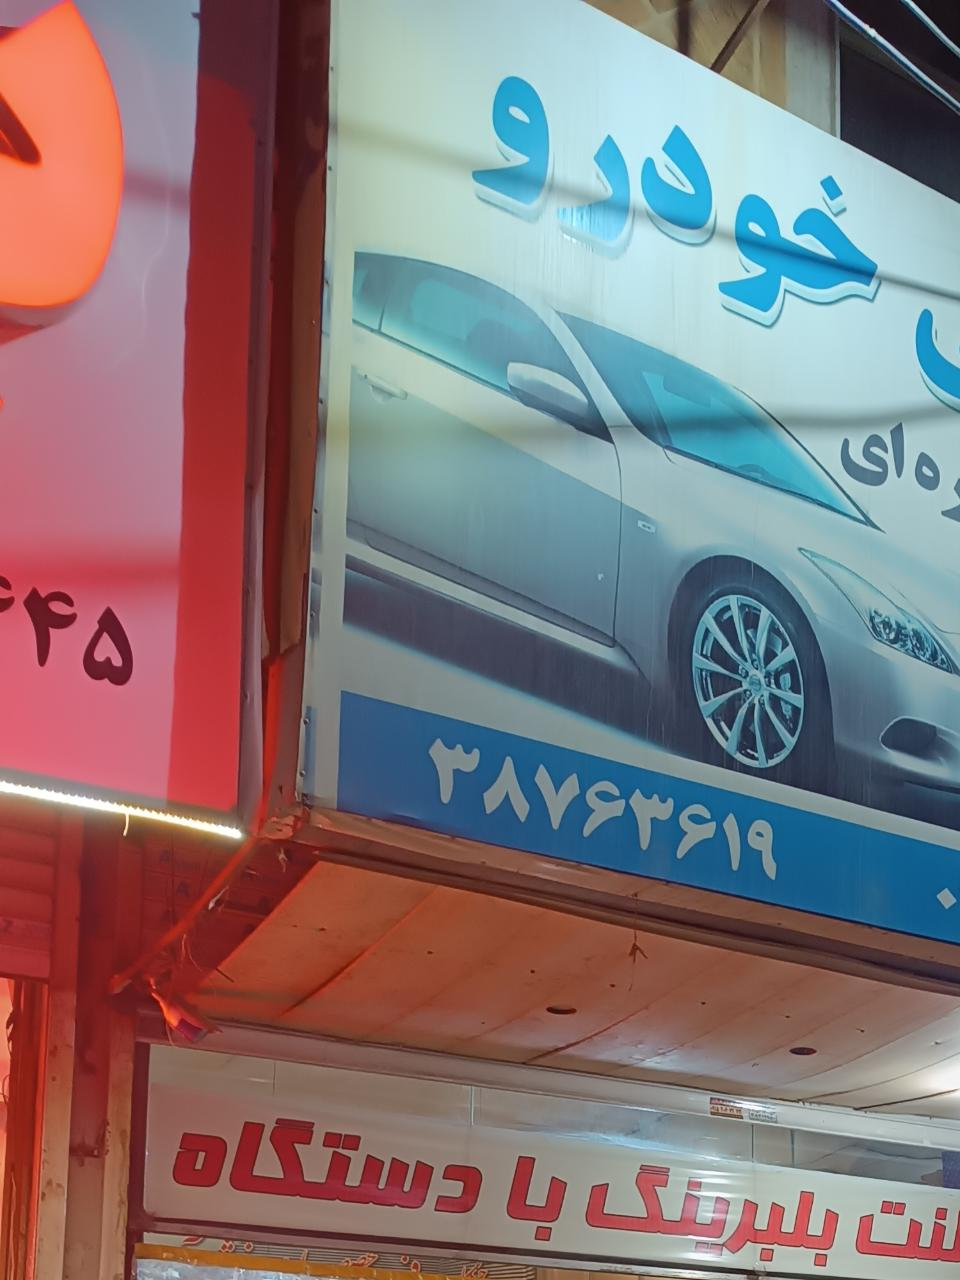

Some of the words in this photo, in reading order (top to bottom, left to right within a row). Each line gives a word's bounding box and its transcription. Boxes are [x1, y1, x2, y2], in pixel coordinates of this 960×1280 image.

[471, 75, 881, 327] خودرو
[428, 738, 777, 881] ۳۸۷۶۳۶۱۹
[172, 1118, 483, 1214] دستگاه
[505, 1156, 567, 1242] با
[585, 1164, 840, 1267] بلبرینگ
